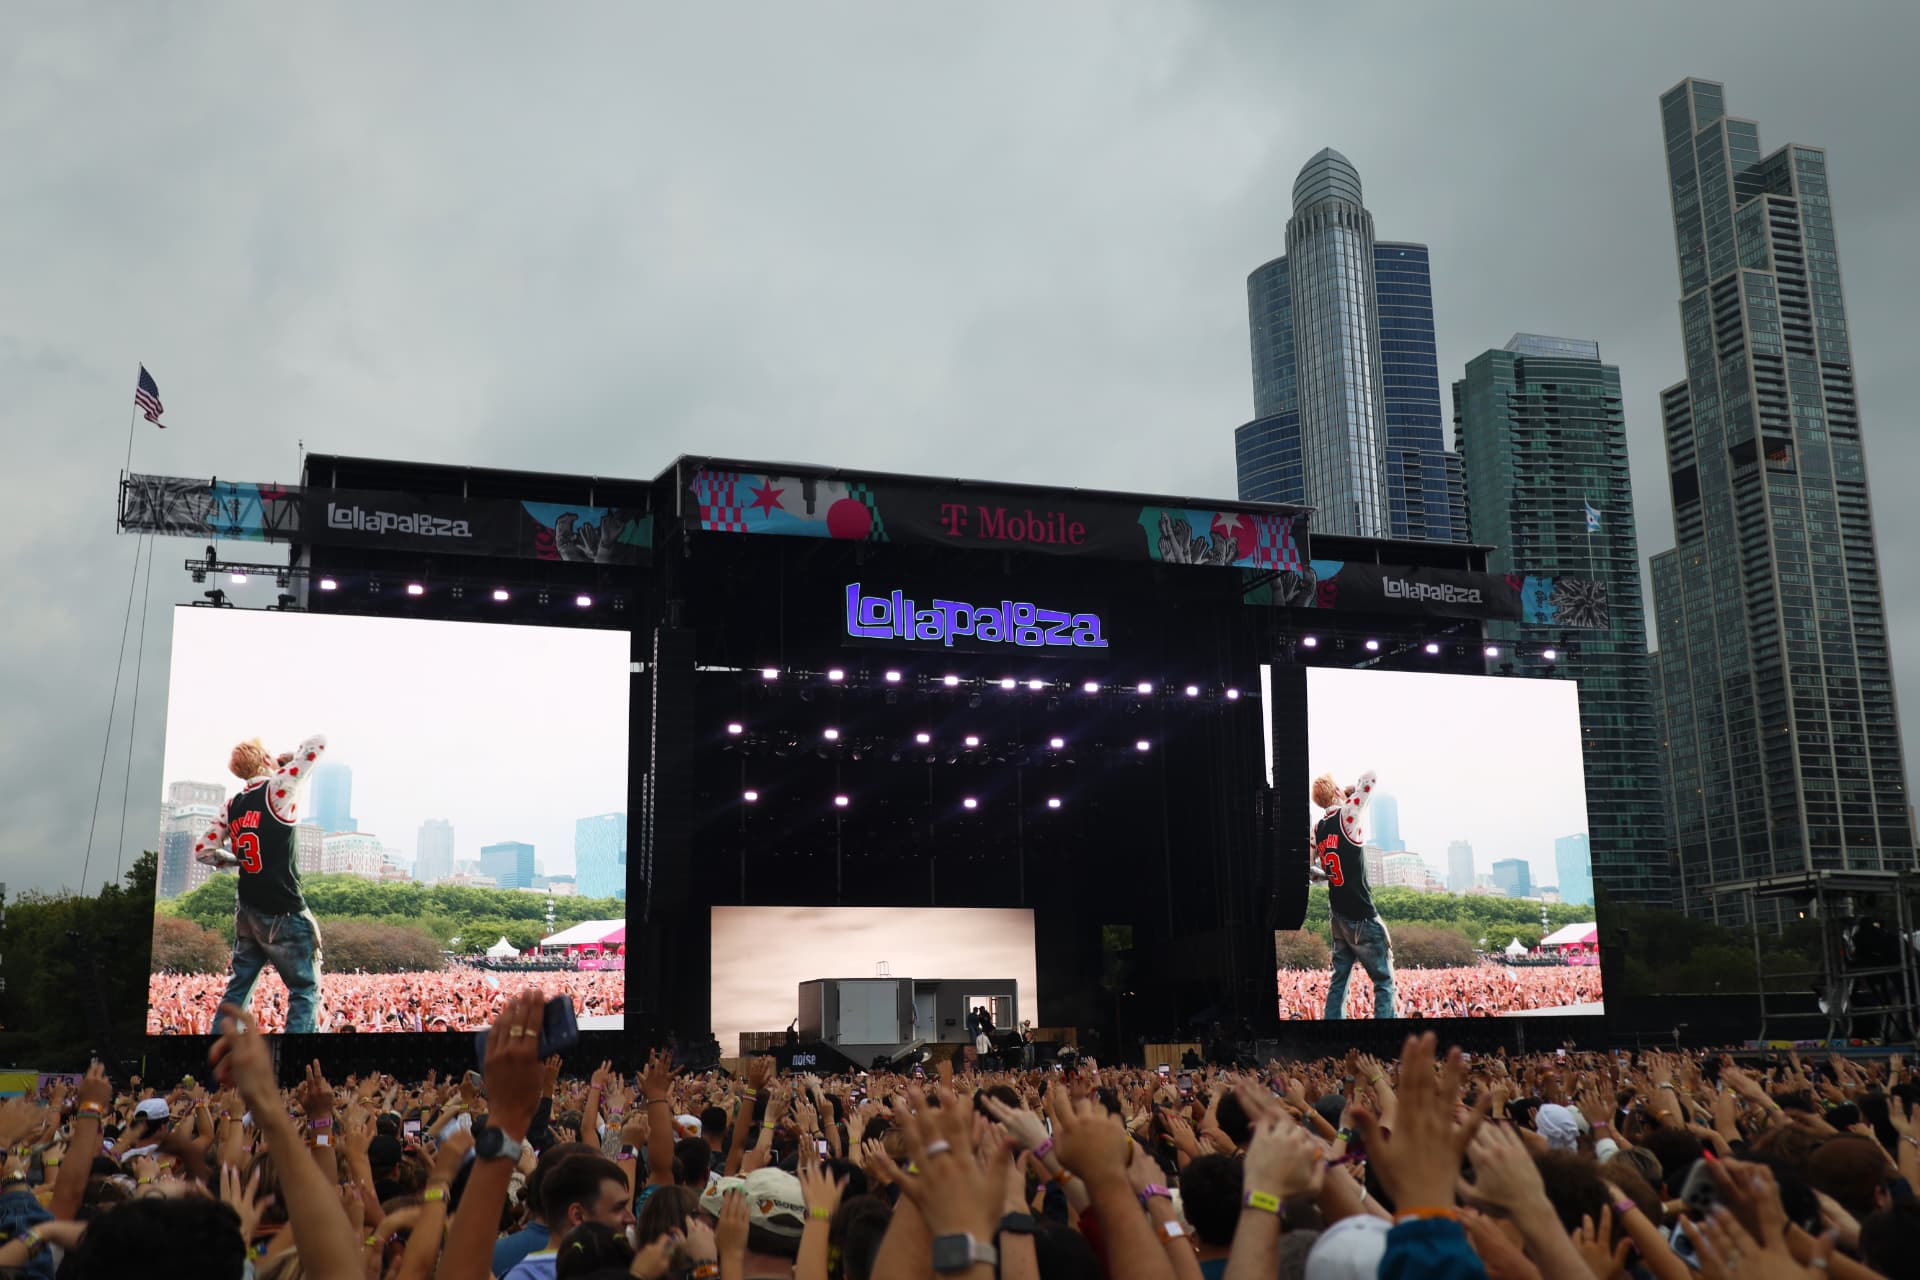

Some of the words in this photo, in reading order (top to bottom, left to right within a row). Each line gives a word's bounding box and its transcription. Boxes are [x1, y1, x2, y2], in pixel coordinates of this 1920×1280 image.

[328, 502, 473, 537] Lollapalooza
[977, 505, 1087, 545] Mobile
[1382, 576, 1483, 603] Lollapalooza
[846, 583, 1108, 647] Lollapalooza
